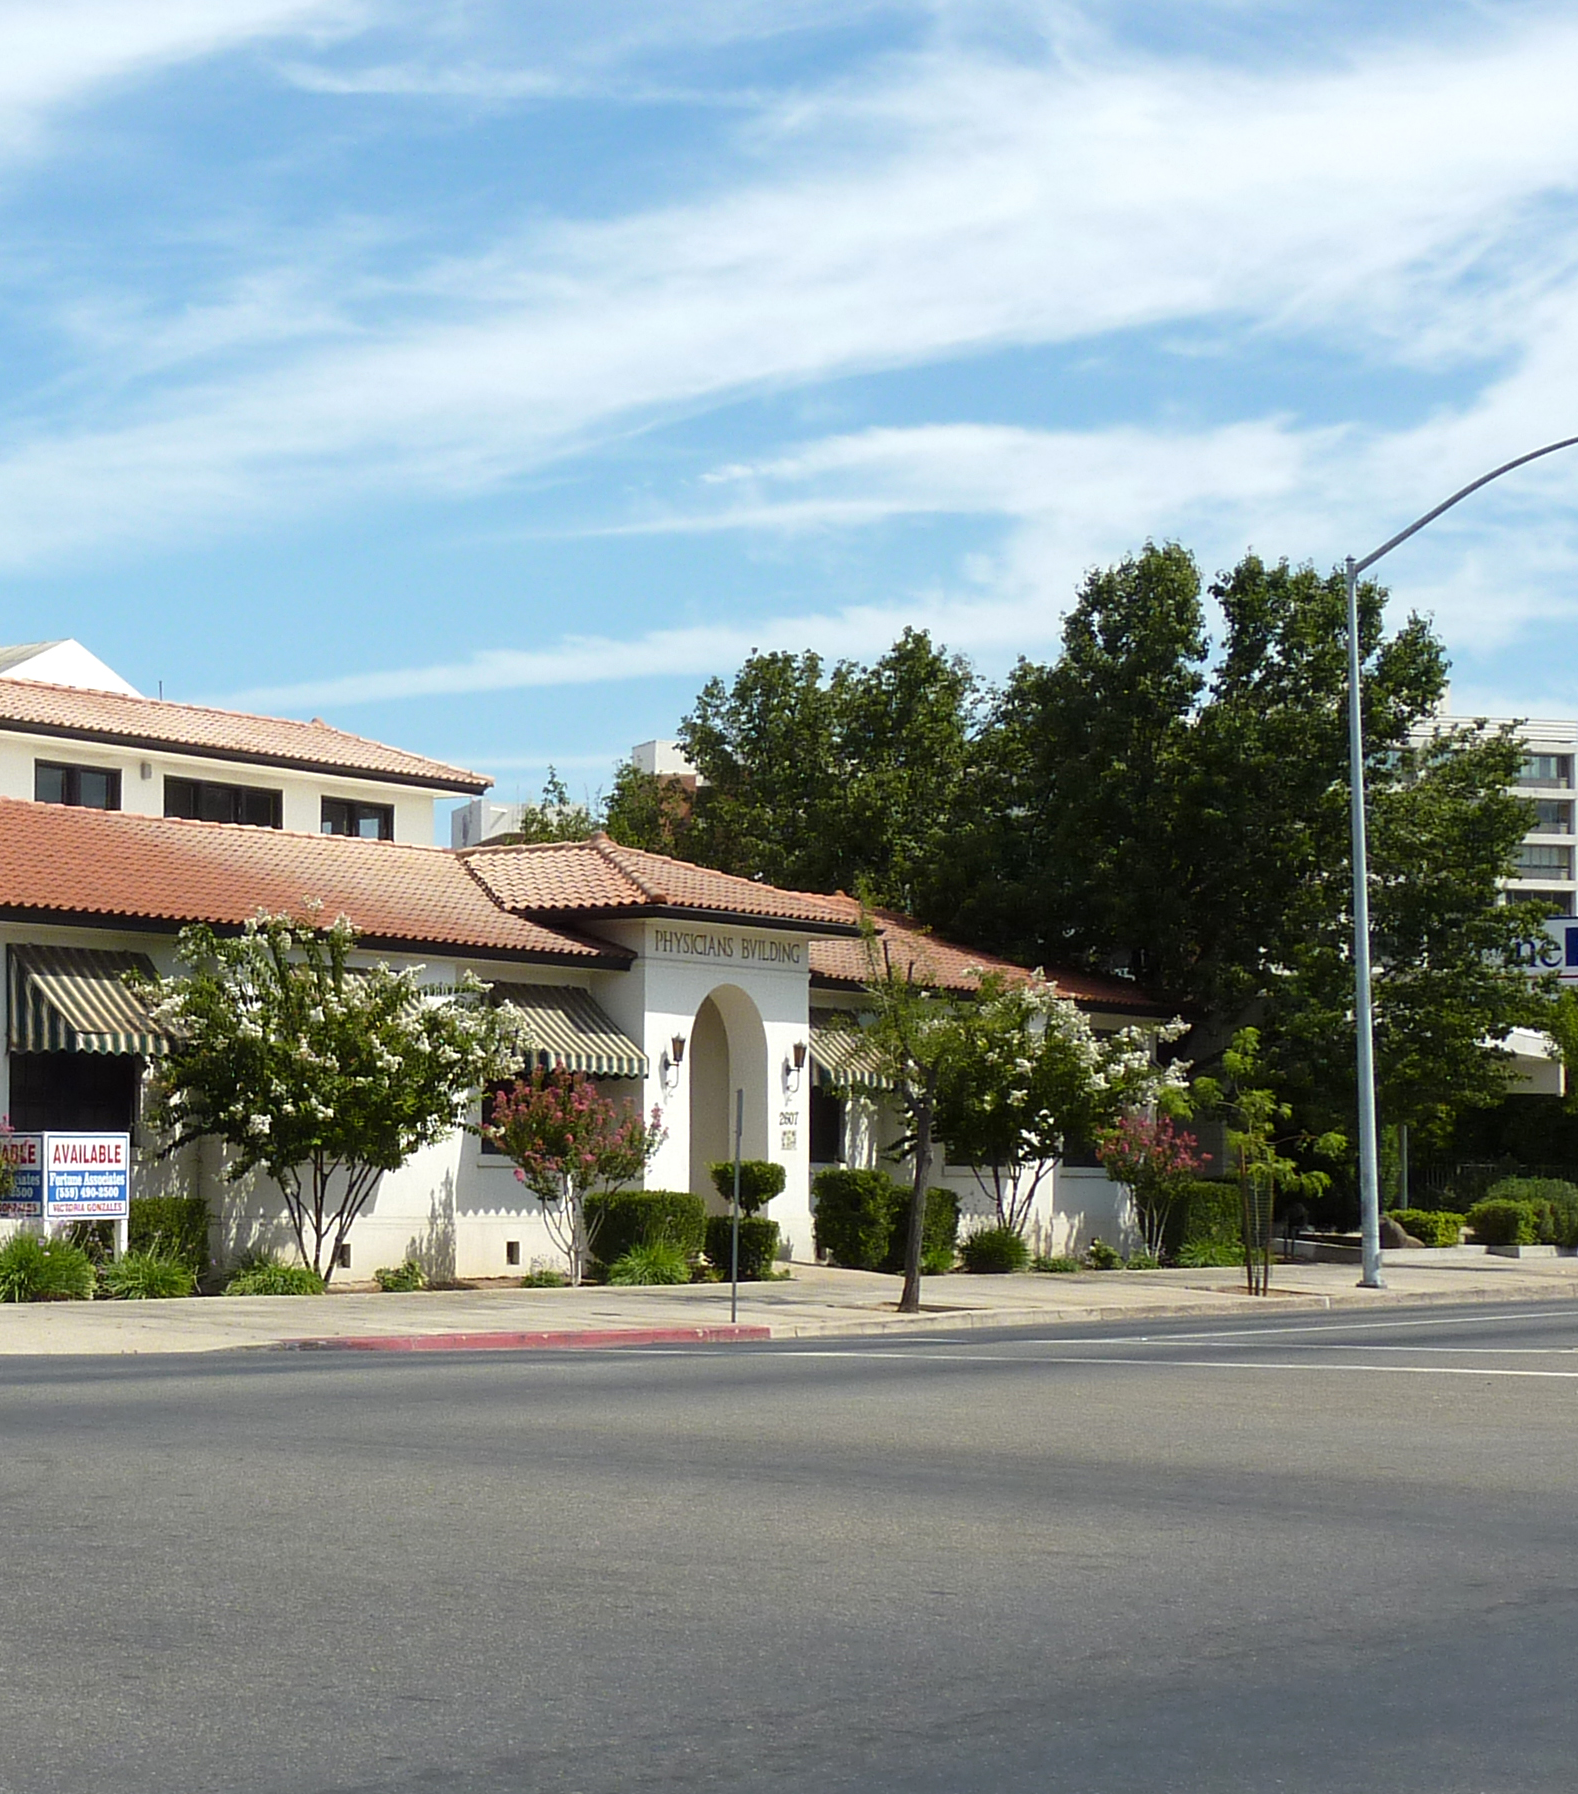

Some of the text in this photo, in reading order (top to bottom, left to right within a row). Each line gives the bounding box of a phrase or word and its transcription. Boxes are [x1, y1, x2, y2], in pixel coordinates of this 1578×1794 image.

[654, 929, 734, 957] PHYSICIANS
[778, 1111, 799, 1126] 2607
[52, 1143, 122, 1164] AVAILABLE
[83, 1171, 126, 1187] Associates
[55, 1186, 120, 1200] (559) 490-2500
[53, 1202, 123, 1213] VICTORIA GONZALES
